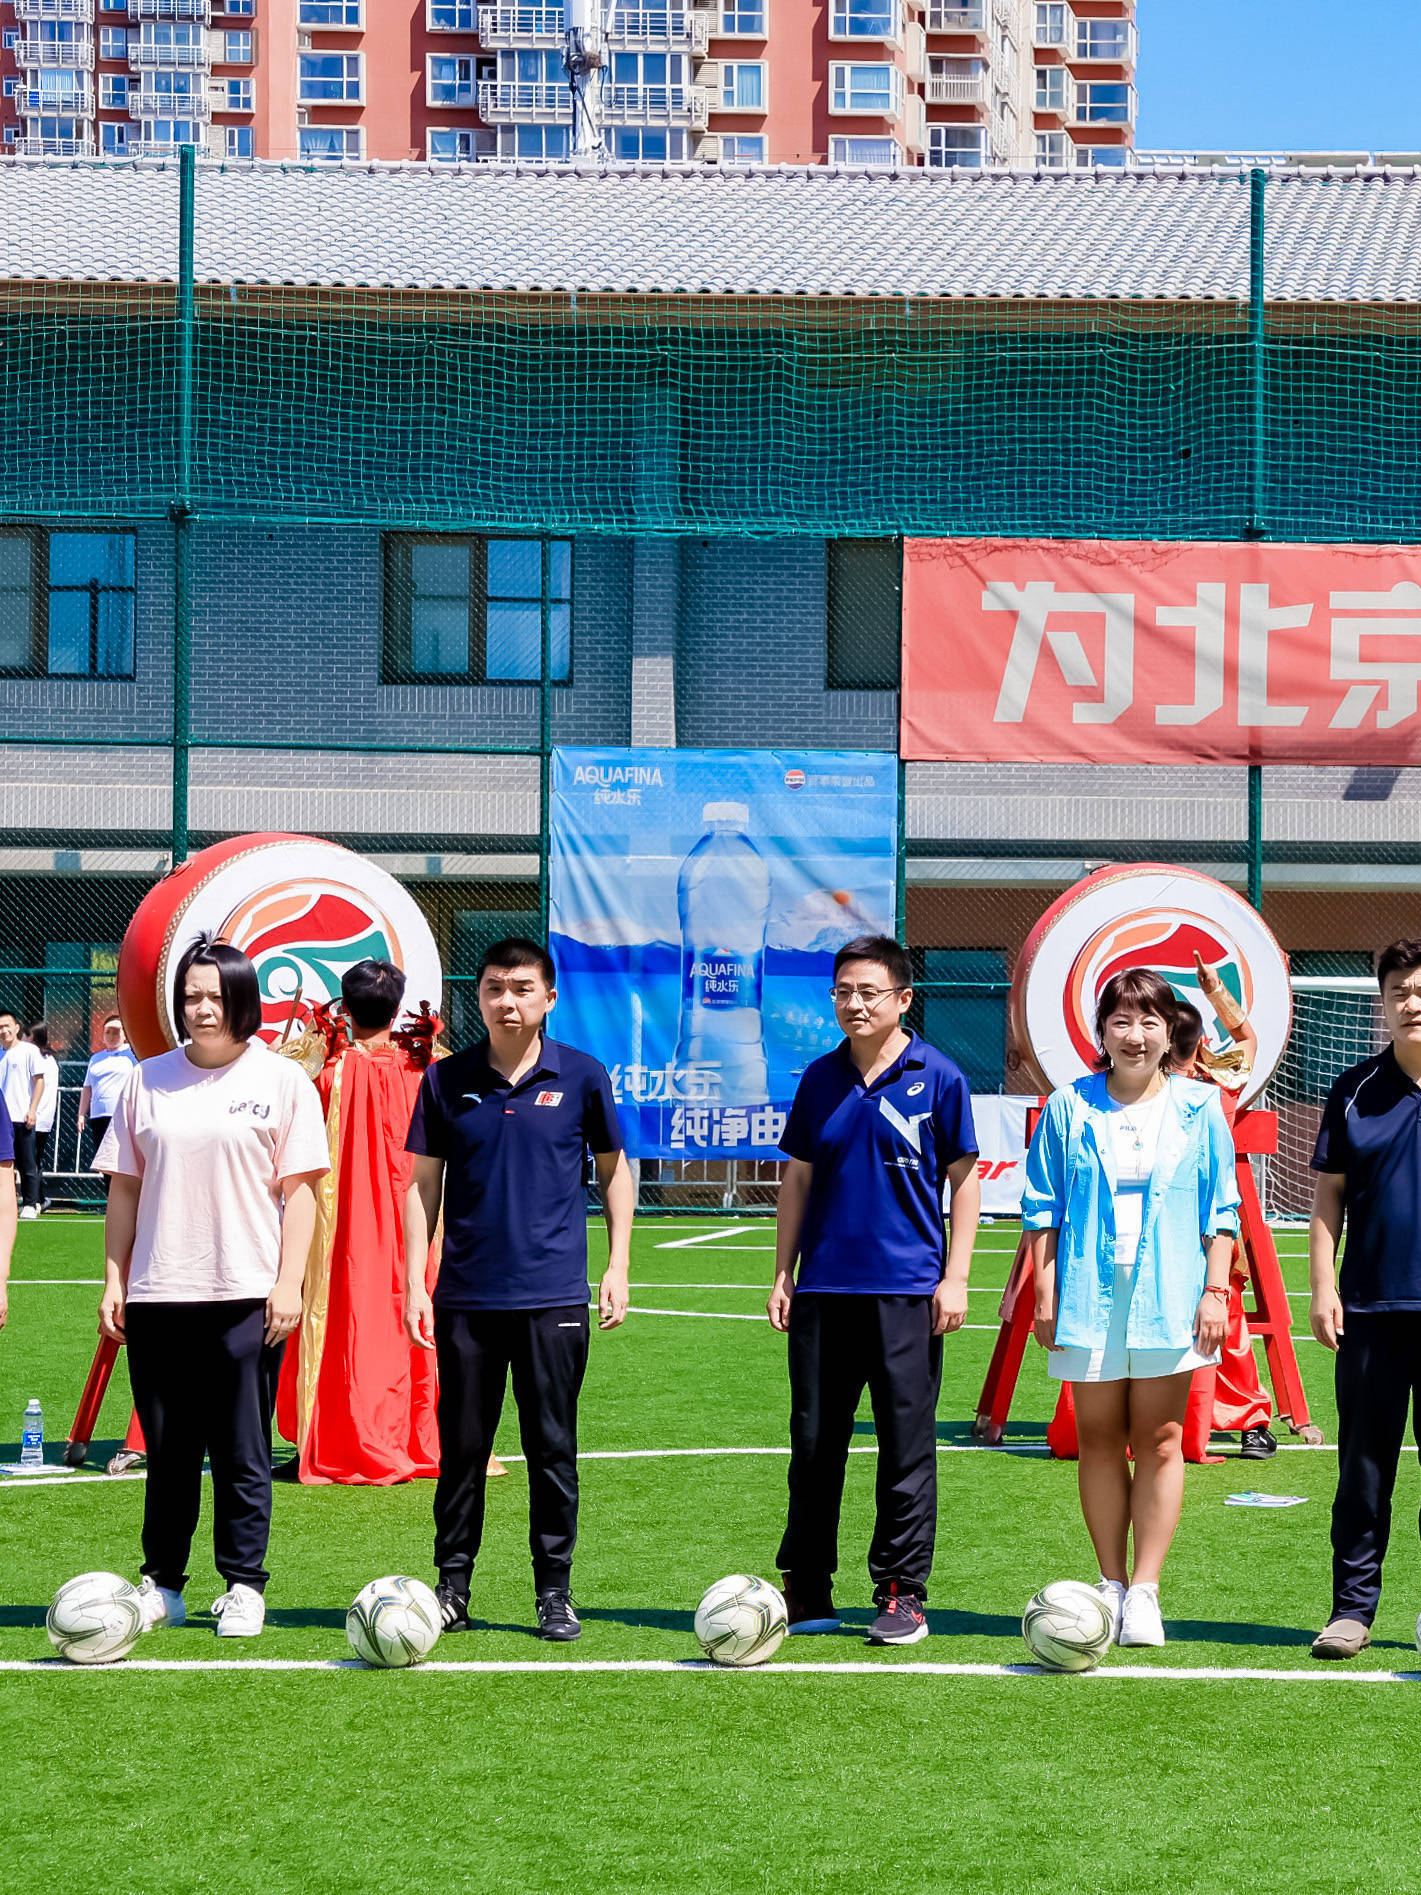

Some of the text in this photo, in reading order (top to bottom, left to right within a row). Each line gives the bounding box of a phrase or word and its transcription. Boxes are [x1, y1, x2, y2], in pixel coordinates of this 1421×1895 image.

[573, 766, 663, 787] AQUAFINA
[593, 788, 642, 806] 纯水乐
[689, 962, 755, 979] AQUAFINA
[705, 980, 739, 992] 纯水乐
[610, 1061, 722, 1104] 纯水乐
[670, 1106, 787, 1149] 纯净由
